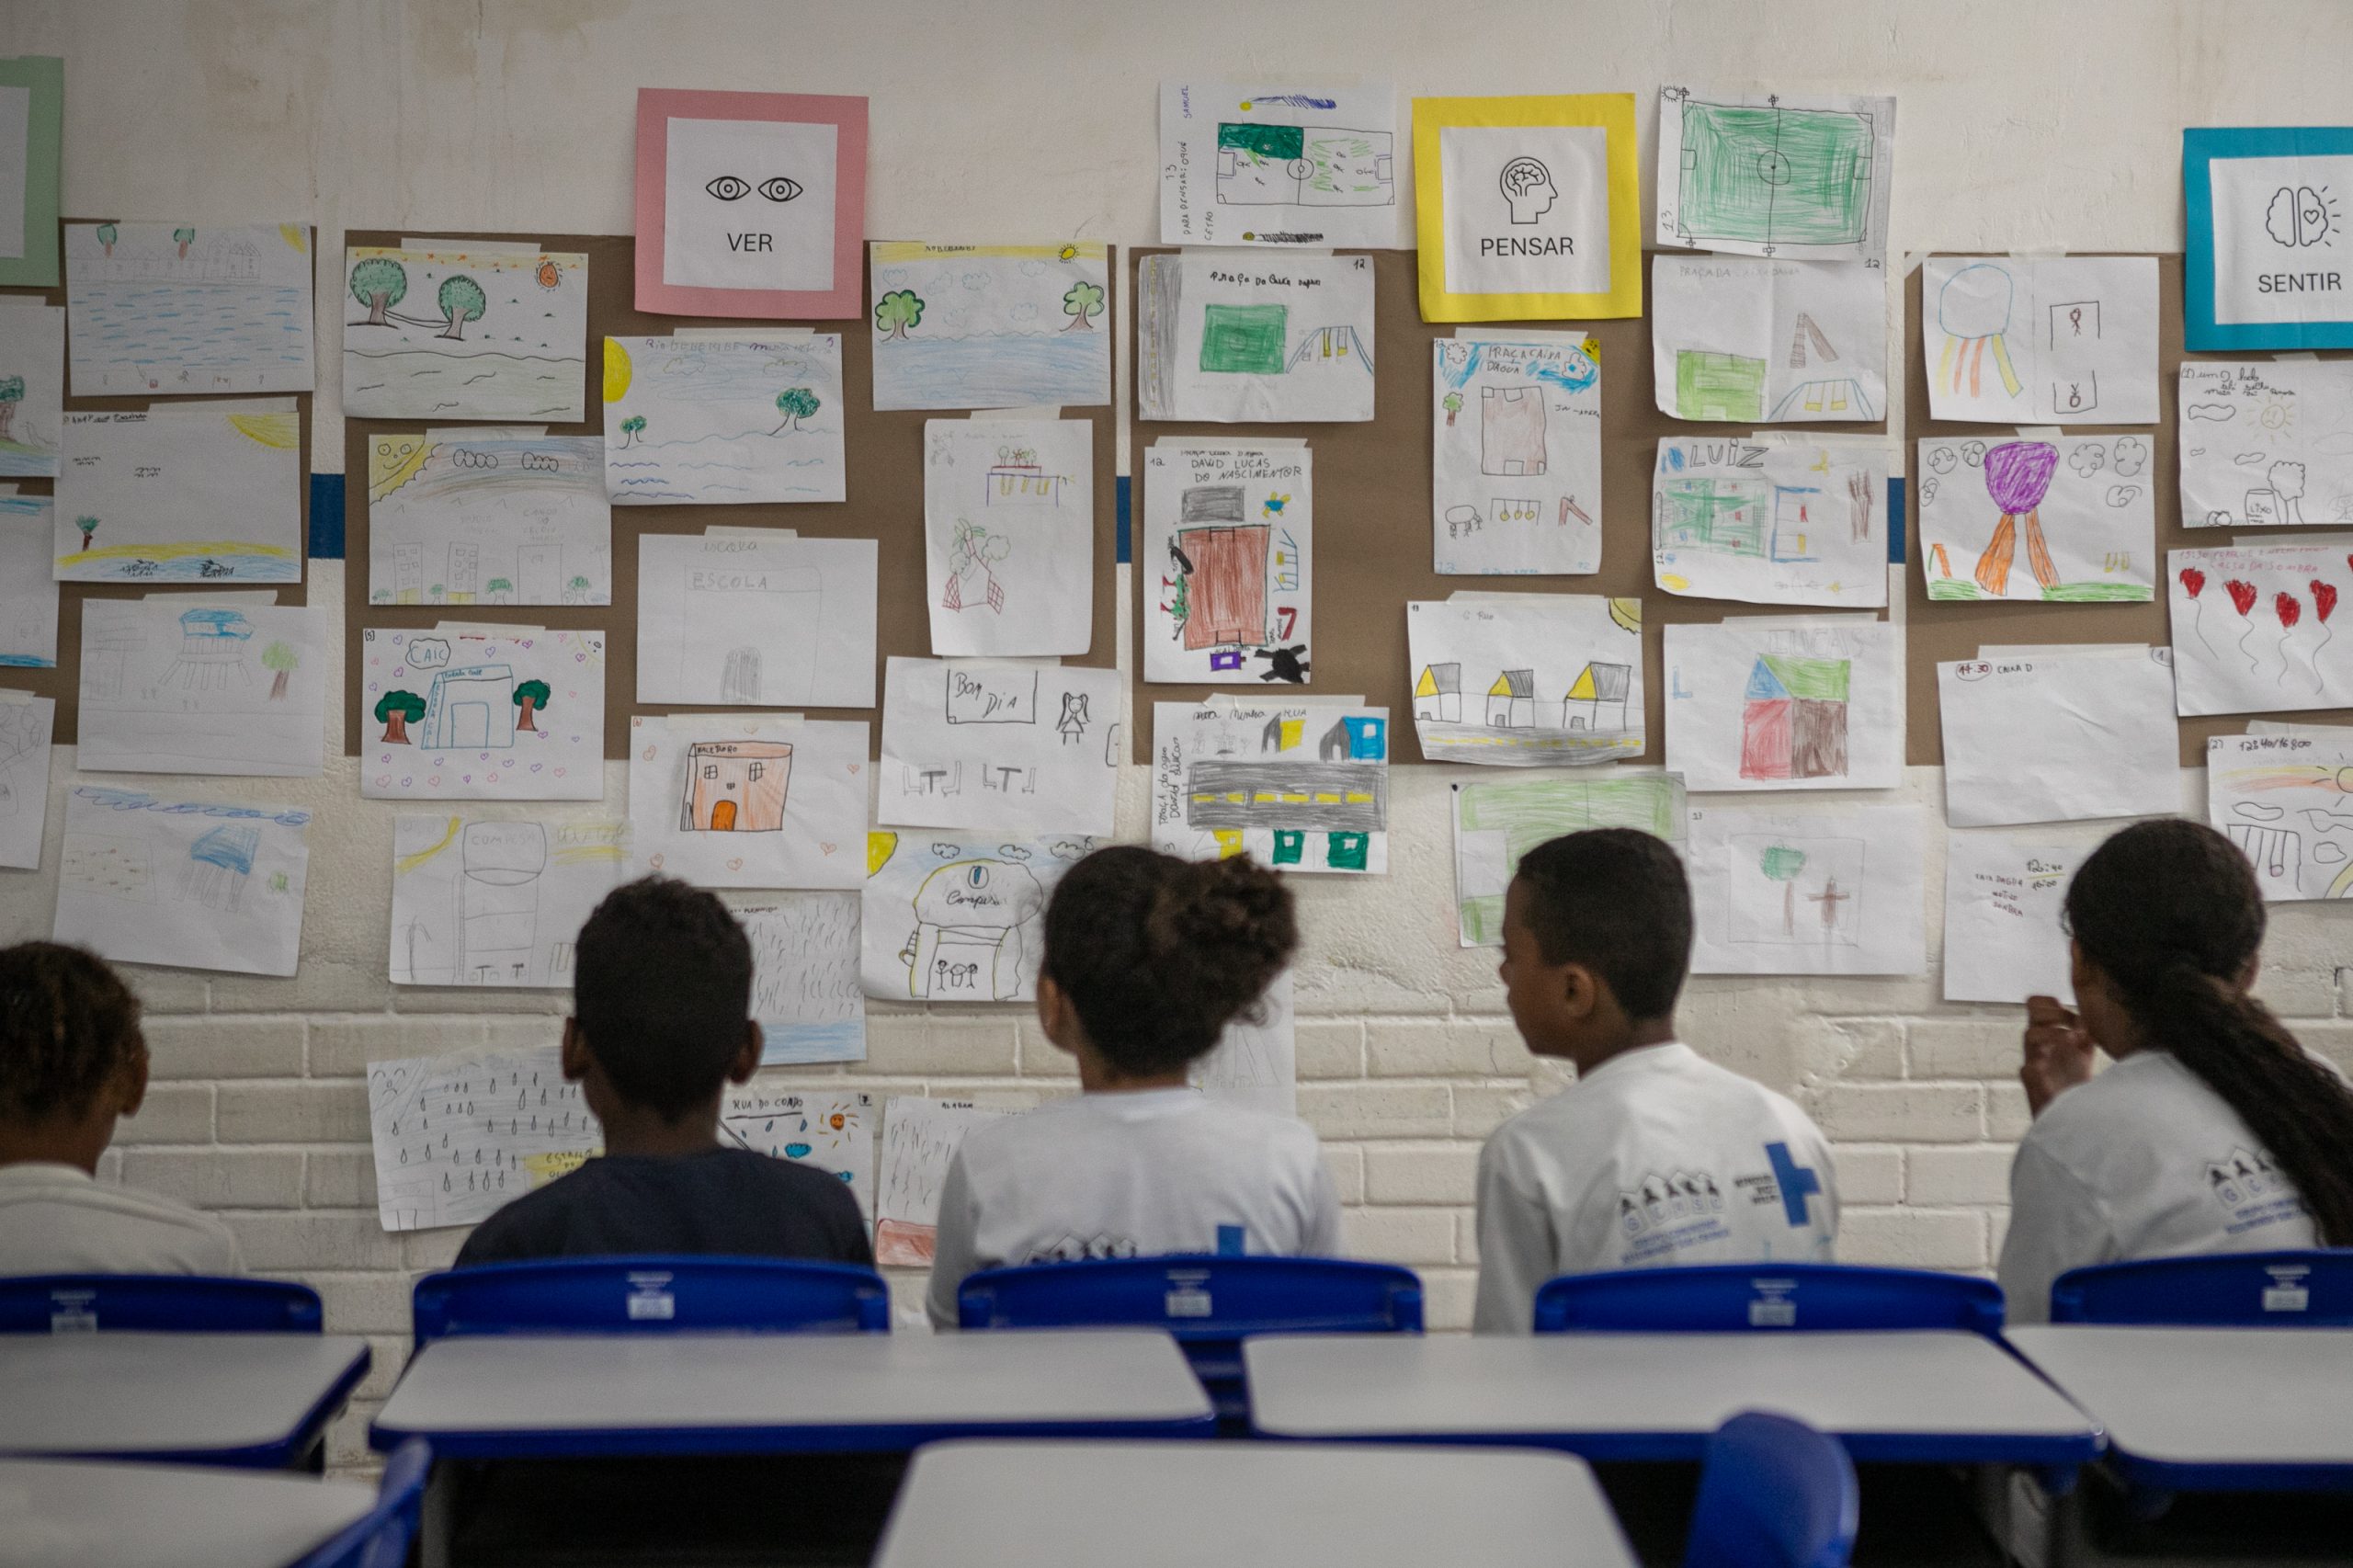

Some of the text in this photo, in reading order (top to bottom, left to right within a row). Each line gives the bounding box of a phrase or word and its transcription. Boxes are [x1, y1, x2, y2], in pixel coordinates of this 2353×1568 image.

[727, 233, 773, 252] VER
[1481, 236, 1574, 256] PENSAR
[1353, 258, 1366, 270] 12
[1865, 258, 1881, 268] 12
[2258, 272, 2342, 293] SENTIR
[1234, 459, 1271, 469] LUCAS
[692, 572, 767, 590] ESCOLA
